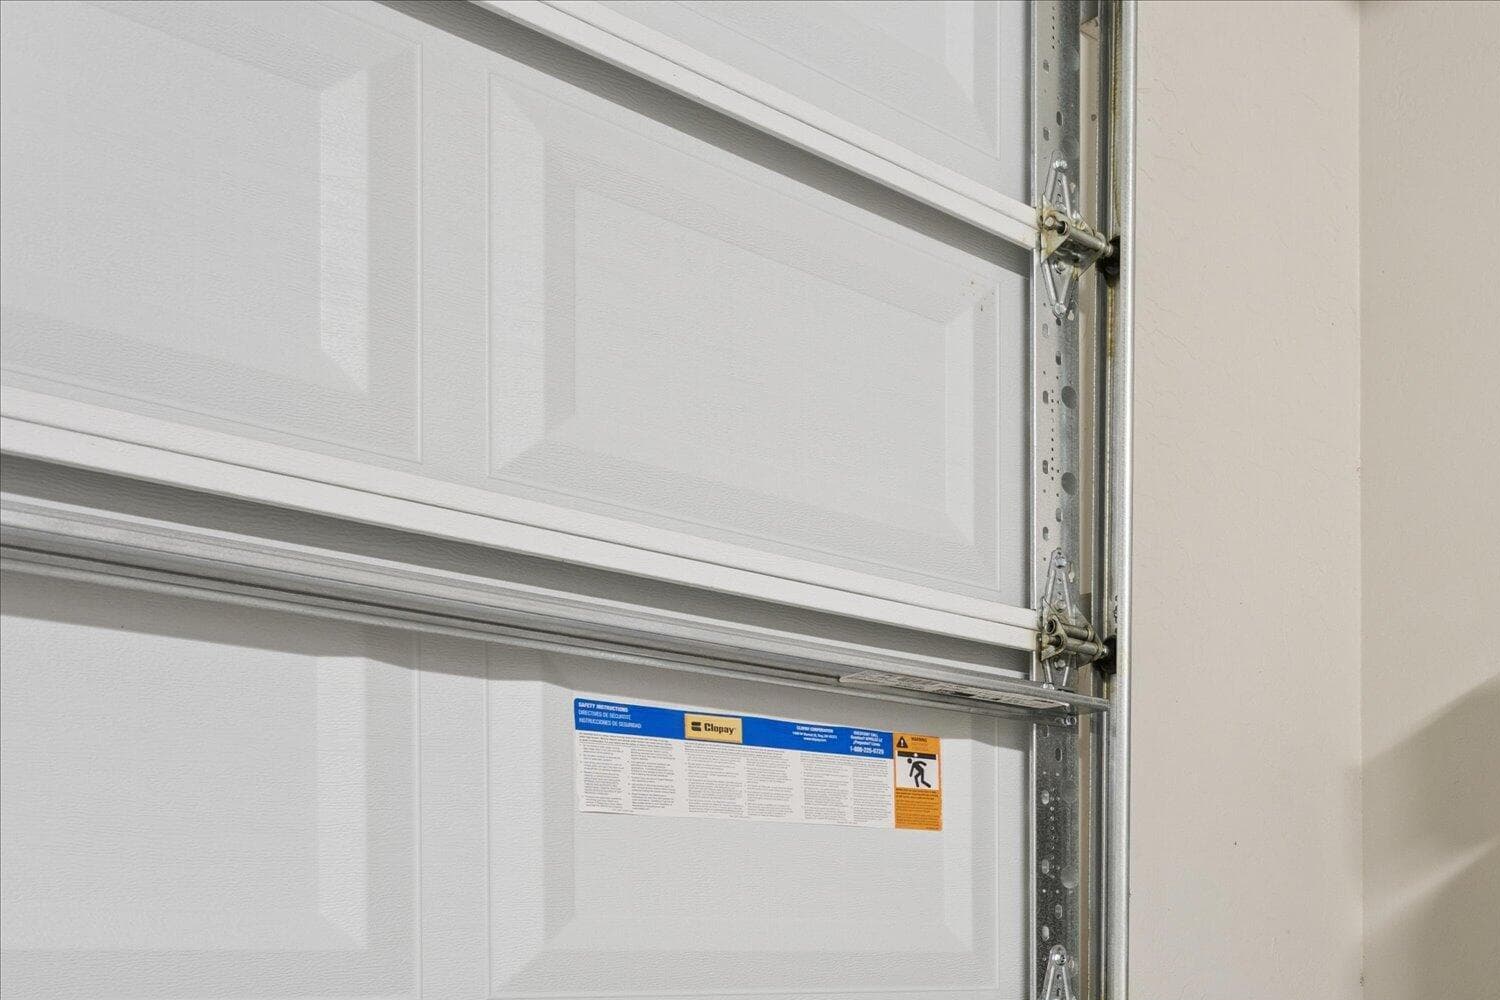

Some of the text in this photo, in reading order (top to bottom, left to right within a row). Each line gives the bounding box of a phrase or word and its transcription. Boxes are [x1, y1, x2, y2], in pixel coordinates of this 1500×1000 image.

[578, 701, 629, 713] SAFETY INSTRUCTIONS
[704, 722, 735, 735] Clopay
